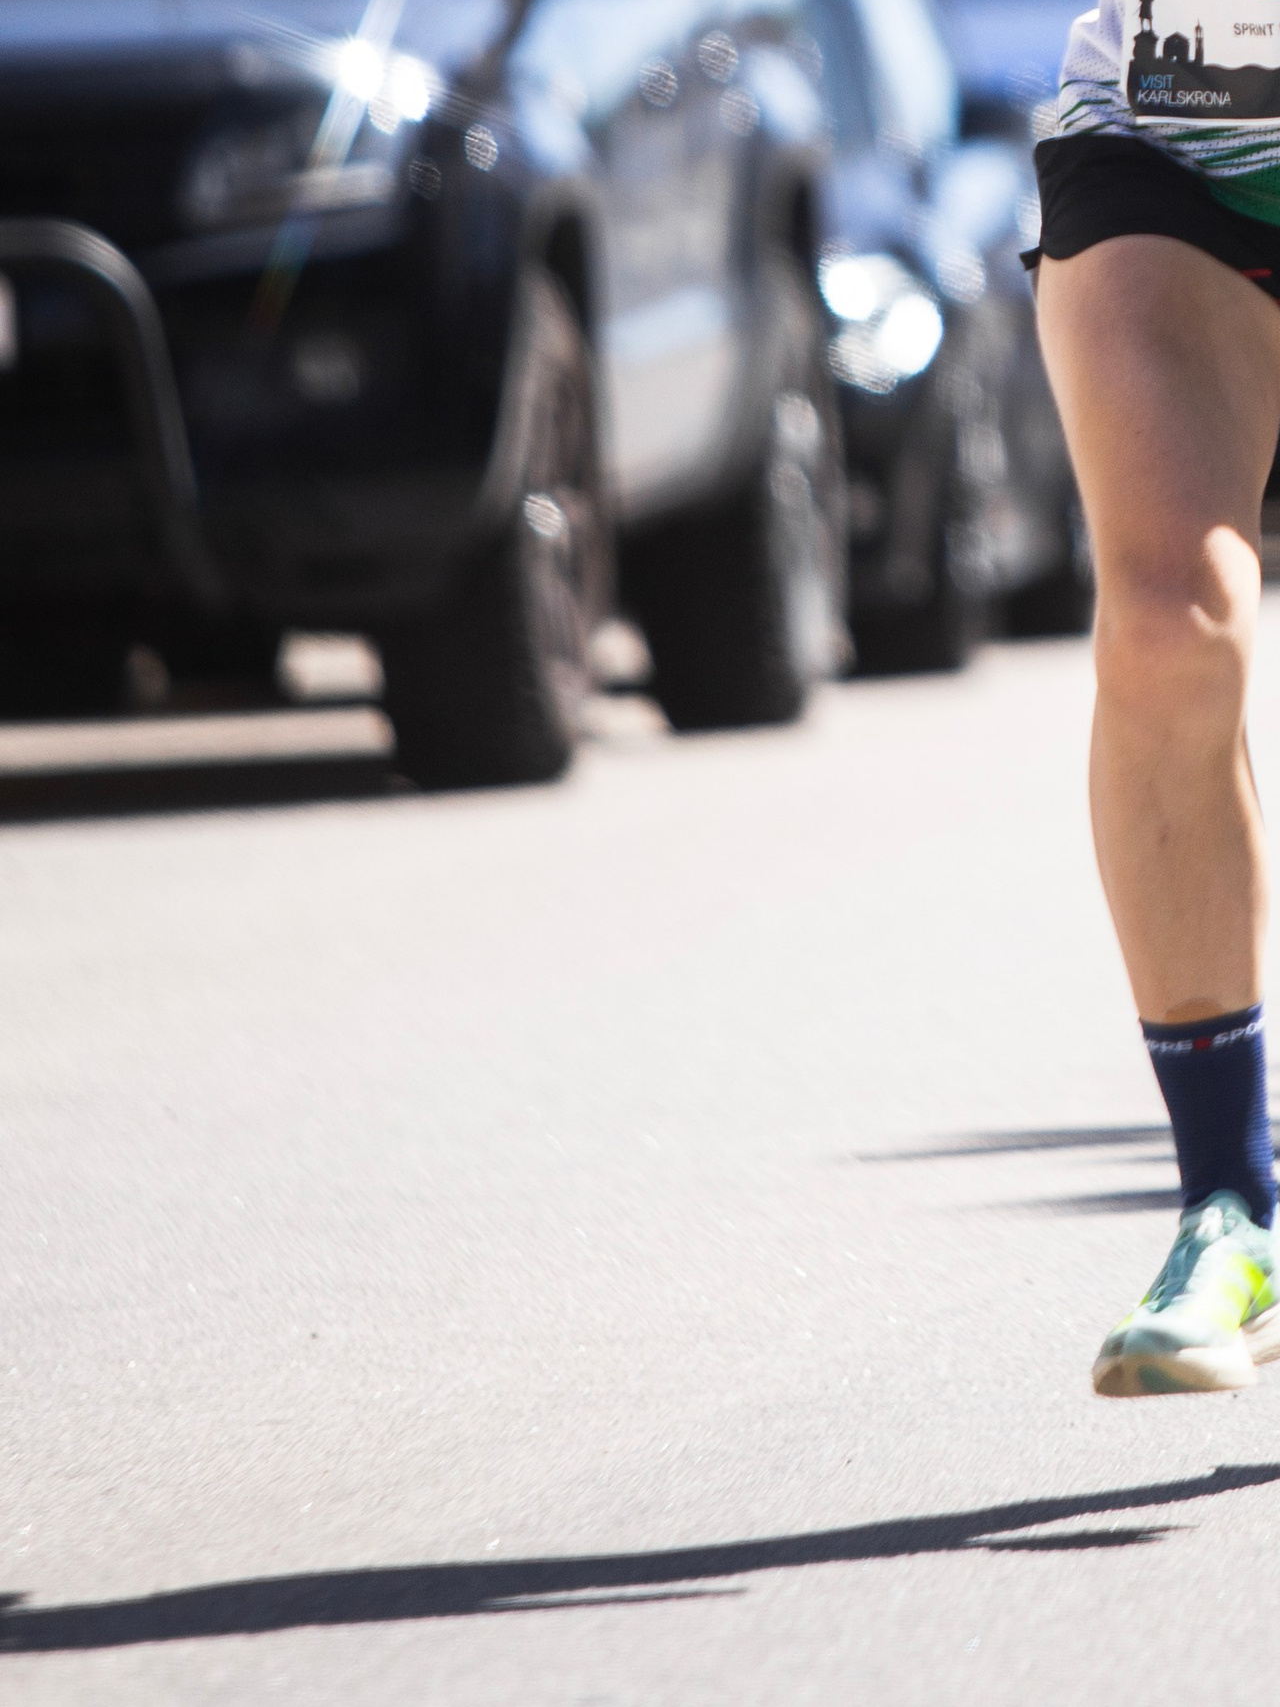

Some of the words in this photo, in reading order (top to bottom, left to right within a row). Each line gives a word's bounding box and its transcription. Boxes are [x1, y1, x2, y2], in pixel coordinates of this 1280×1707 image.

[1233, 22, 1274, 36] SPRINT
[1140, 74, 1175, 89] VISIT
[1137, 89, 1232, 107] KARLSKRONA
